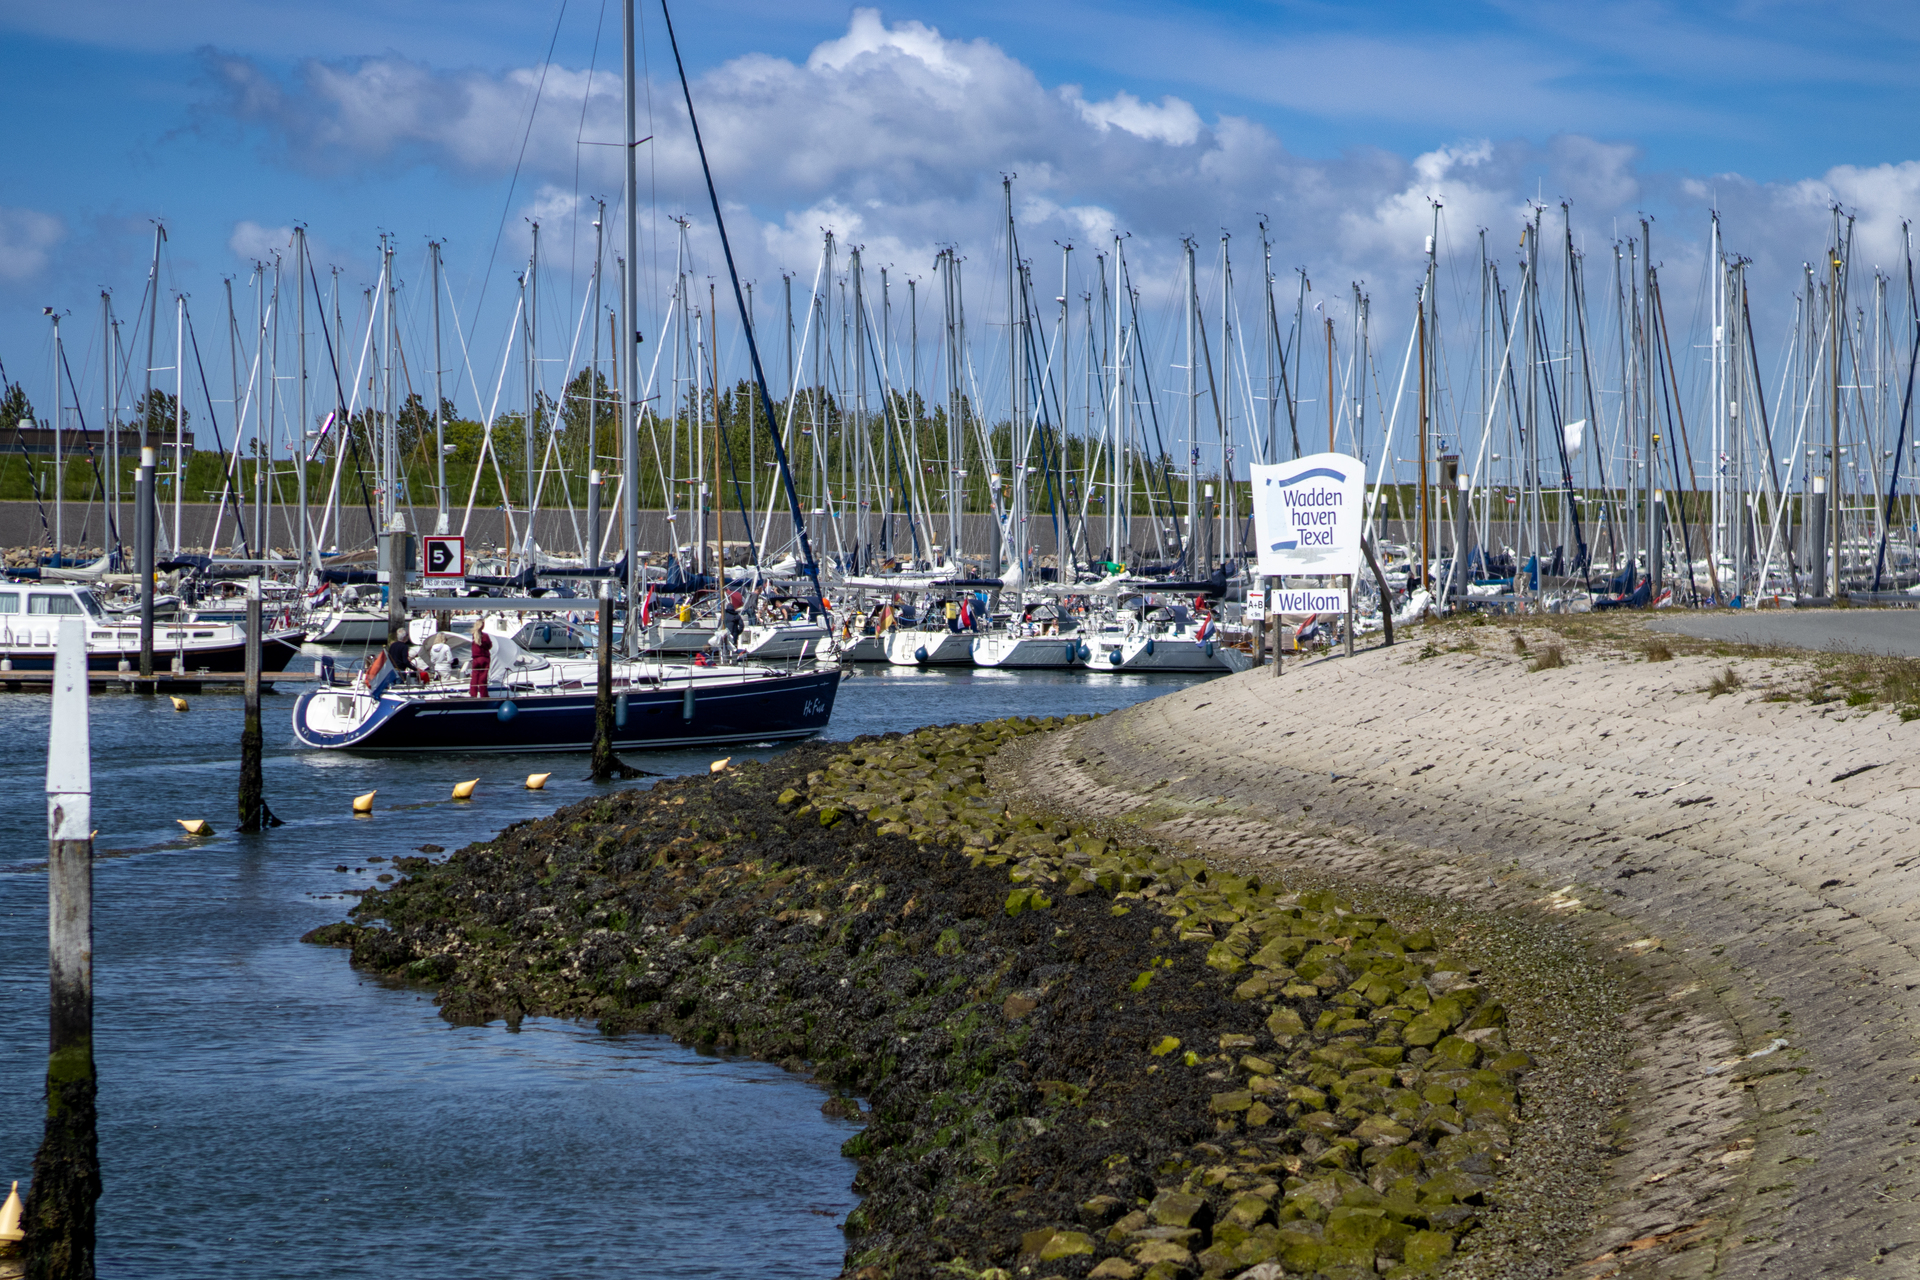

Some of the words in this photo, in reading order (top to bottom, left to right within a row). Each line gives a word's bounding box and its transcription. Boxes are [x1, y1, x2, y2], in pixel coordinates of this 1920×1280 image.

[1284, 488, 1342, 507] Wadden
[1292, 508, 1336, 526] haven
[1296, 527, 1333, 546] Texel
[434, 550, 445, 563] 5
[1248, 600, 1263, 609] A+B
[1279, 592, 1339, 611] Welkom
[803, 699, 812, 717] Hi
[812, 698, 825, 716] Five
